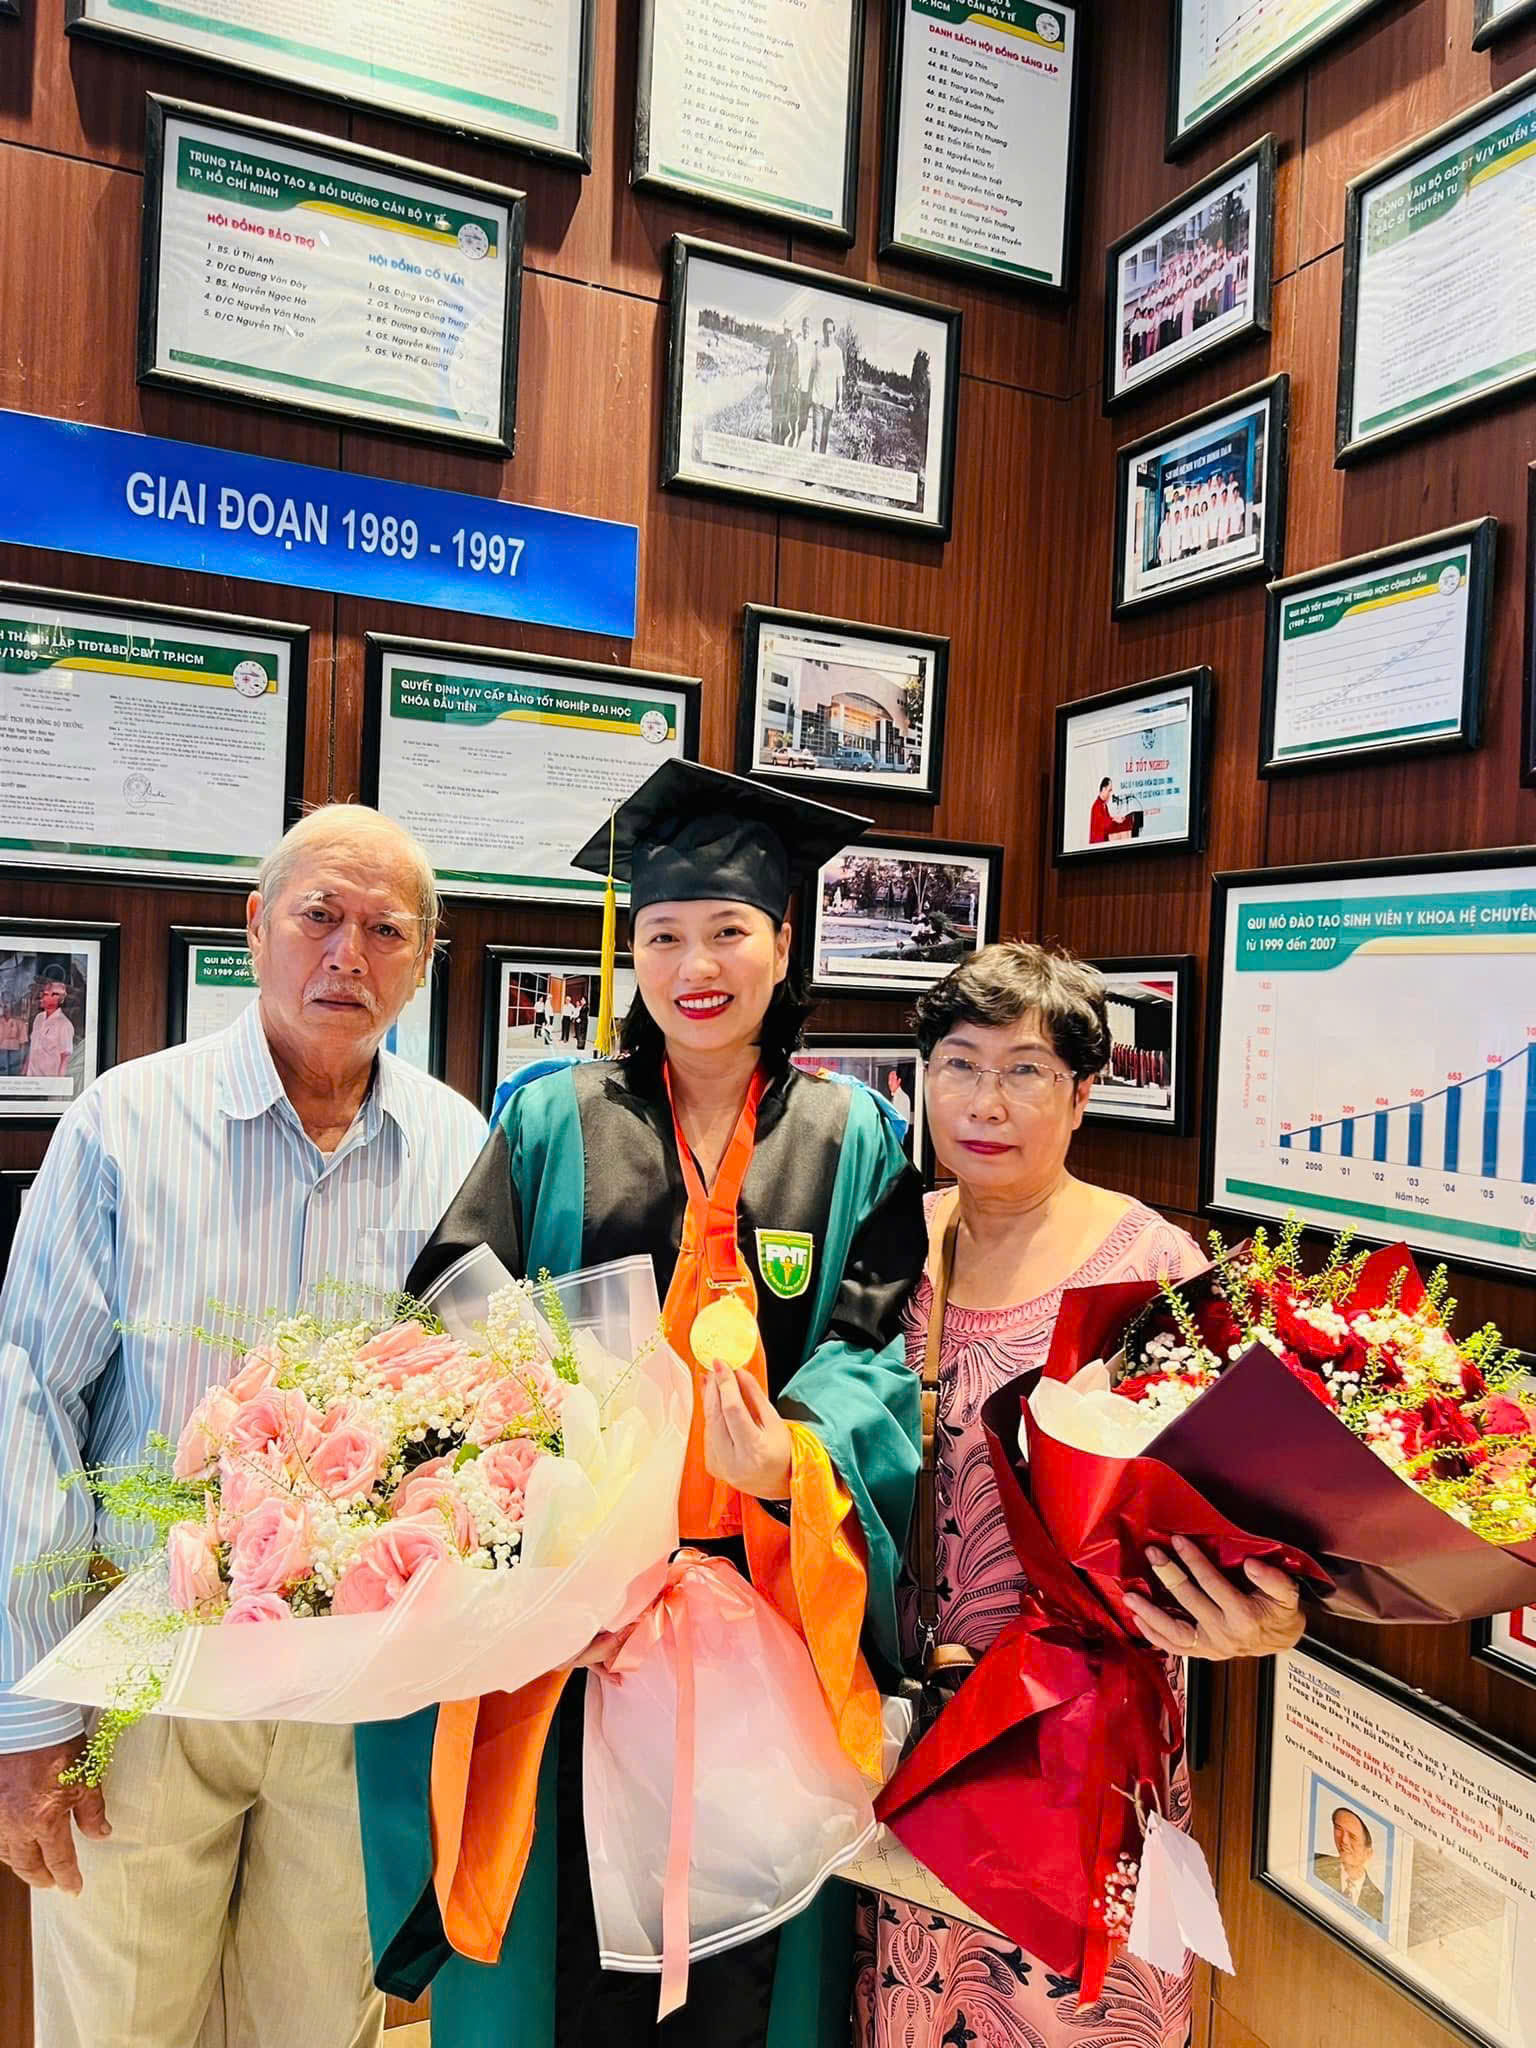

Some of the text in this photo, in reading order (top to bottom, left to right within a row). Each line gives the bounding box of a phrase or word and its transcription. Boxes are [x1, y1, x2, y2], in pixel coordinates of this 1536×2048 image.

[929, 25, 953, 39] DANH
[189, 167, 279, 198] TP. HỒ CHÍ MINH
[189, 151, 227, 167] TRUNG
[230, 160, 252, 175] TÂM
[256, 168, 281, 182] ĐÀO
[283, 174, 306, 189] TẠO
[308, 182, 316, 192] &
[382, 200, 405, 215] CÁN
[408, 208, 422, 221] BỘ
[425, 212, 432, 222] Y
[207, 214, 228, 227] HỘI
[232, 218, 265, 236] ĐỒNG
[368, 254, 388, 267] HỘI
[126, 471, 525, 577] GIAI ĐOẠN 1989 - 1997
[163, 652, 204, 665] TP.HCM
[401, 679, 433, 692] QUYẾT
[435, 683, 460, 697] ĐỊNH
[462, 686, 481, 698] V/V
[484, 687, 505, 701] CẤP
[537, 694, 554, 707] TỐT
[555, 699, 590, 713] NGHIỆP
[592, 702, 608, 716] ĐẠI
[610, 705, 632, 719] HỌC
[457, 698, 477, 712] TIÊN
[1247, 916, 1266, 930] QUI
[1268, 912, 1287, 928] MÔ
[1289, 912, 1314, 928] ĐÀO
[1318, 914, 1341, 932] TẠO
[1343, 912, 1371, 927] SINH
[1375, 909, 1402, 926] VIÊN
[1406, 911, 1414, 925] Y
[1417, 910, 1453, 925] KHOA
[1459, 905, 1477, 928] HỆ
[1259, 939, 1284, 951] 1999
[1286, 936, 1307, 951] đến
[1310, 937, 1336, 950] 2007
[1305, 1162, 1323, 1172] 2000
